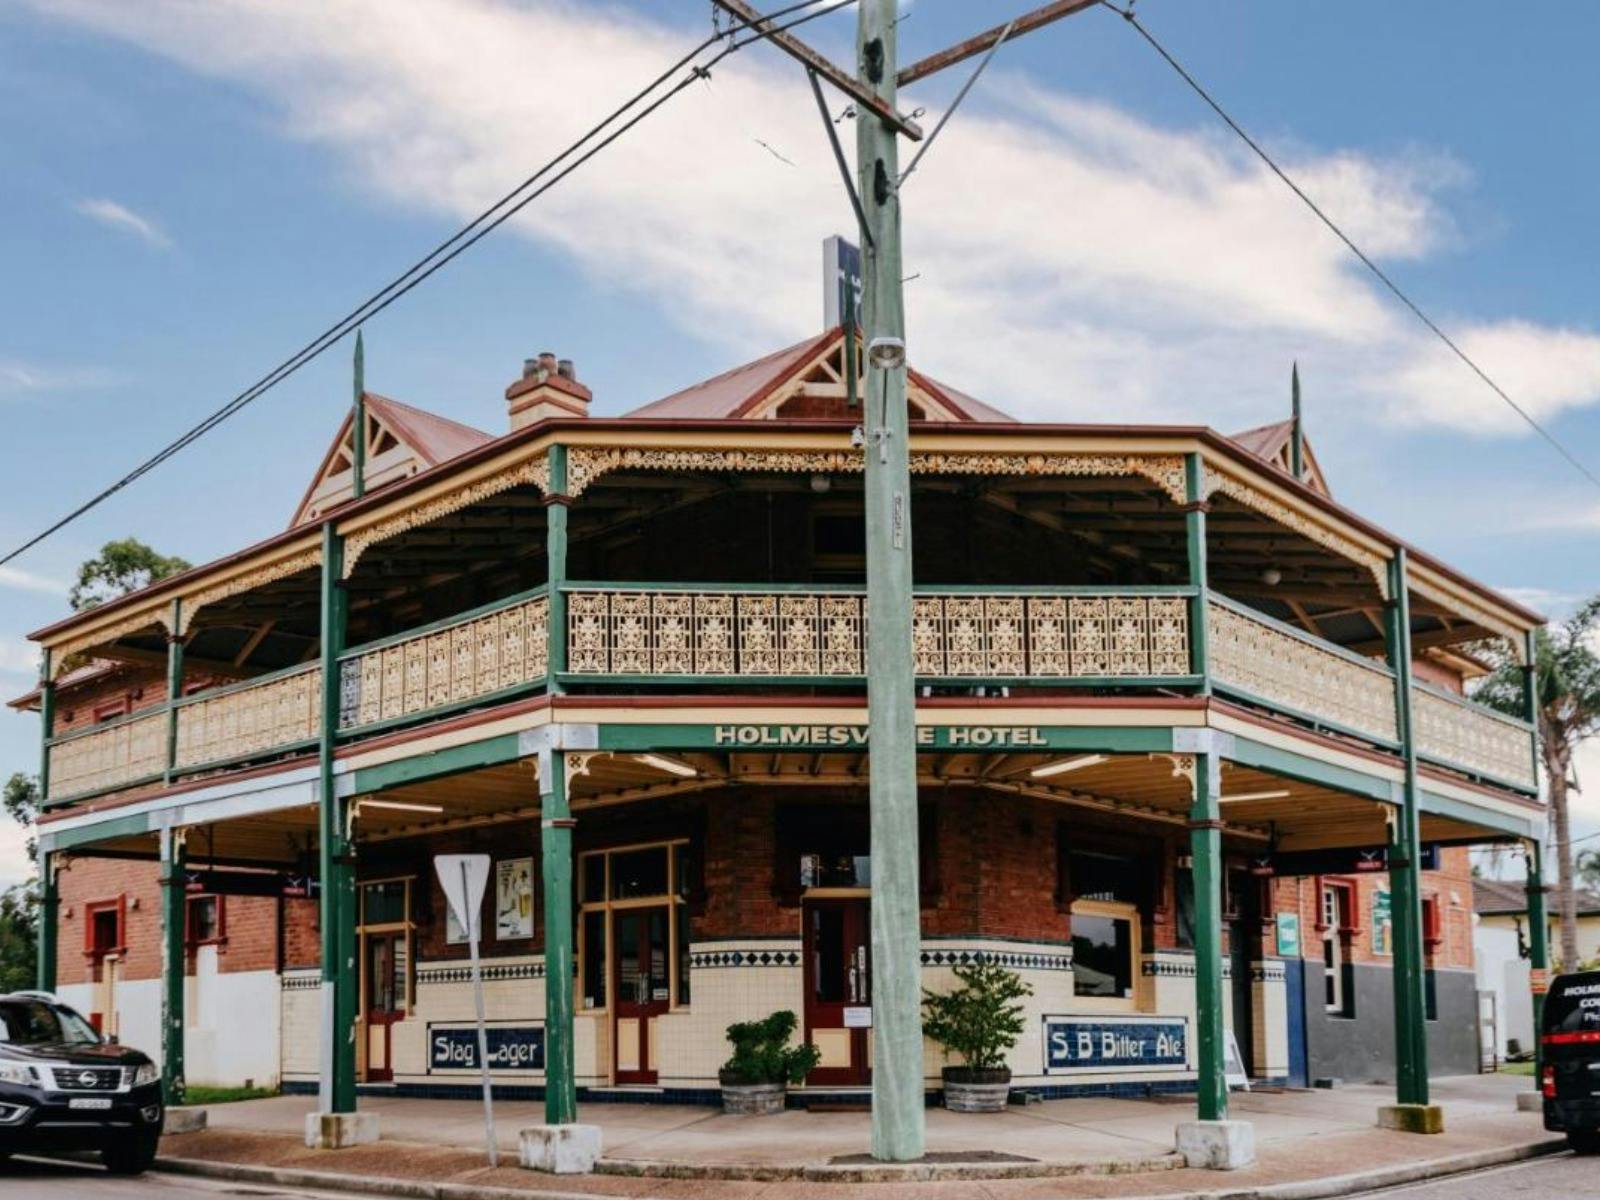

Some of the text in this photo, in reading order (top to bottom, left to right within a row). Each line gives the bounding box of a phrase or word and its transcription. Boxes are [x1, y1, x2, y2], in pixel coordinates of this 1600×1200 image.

[714, 726, 1047, 745] HOLMESVE HOTEL
[434, 1036, 474, 1066] Stag
[1102, 1032, 1146, 1058] Bitter
[1155, 1031, 1182, 1057] Ale
